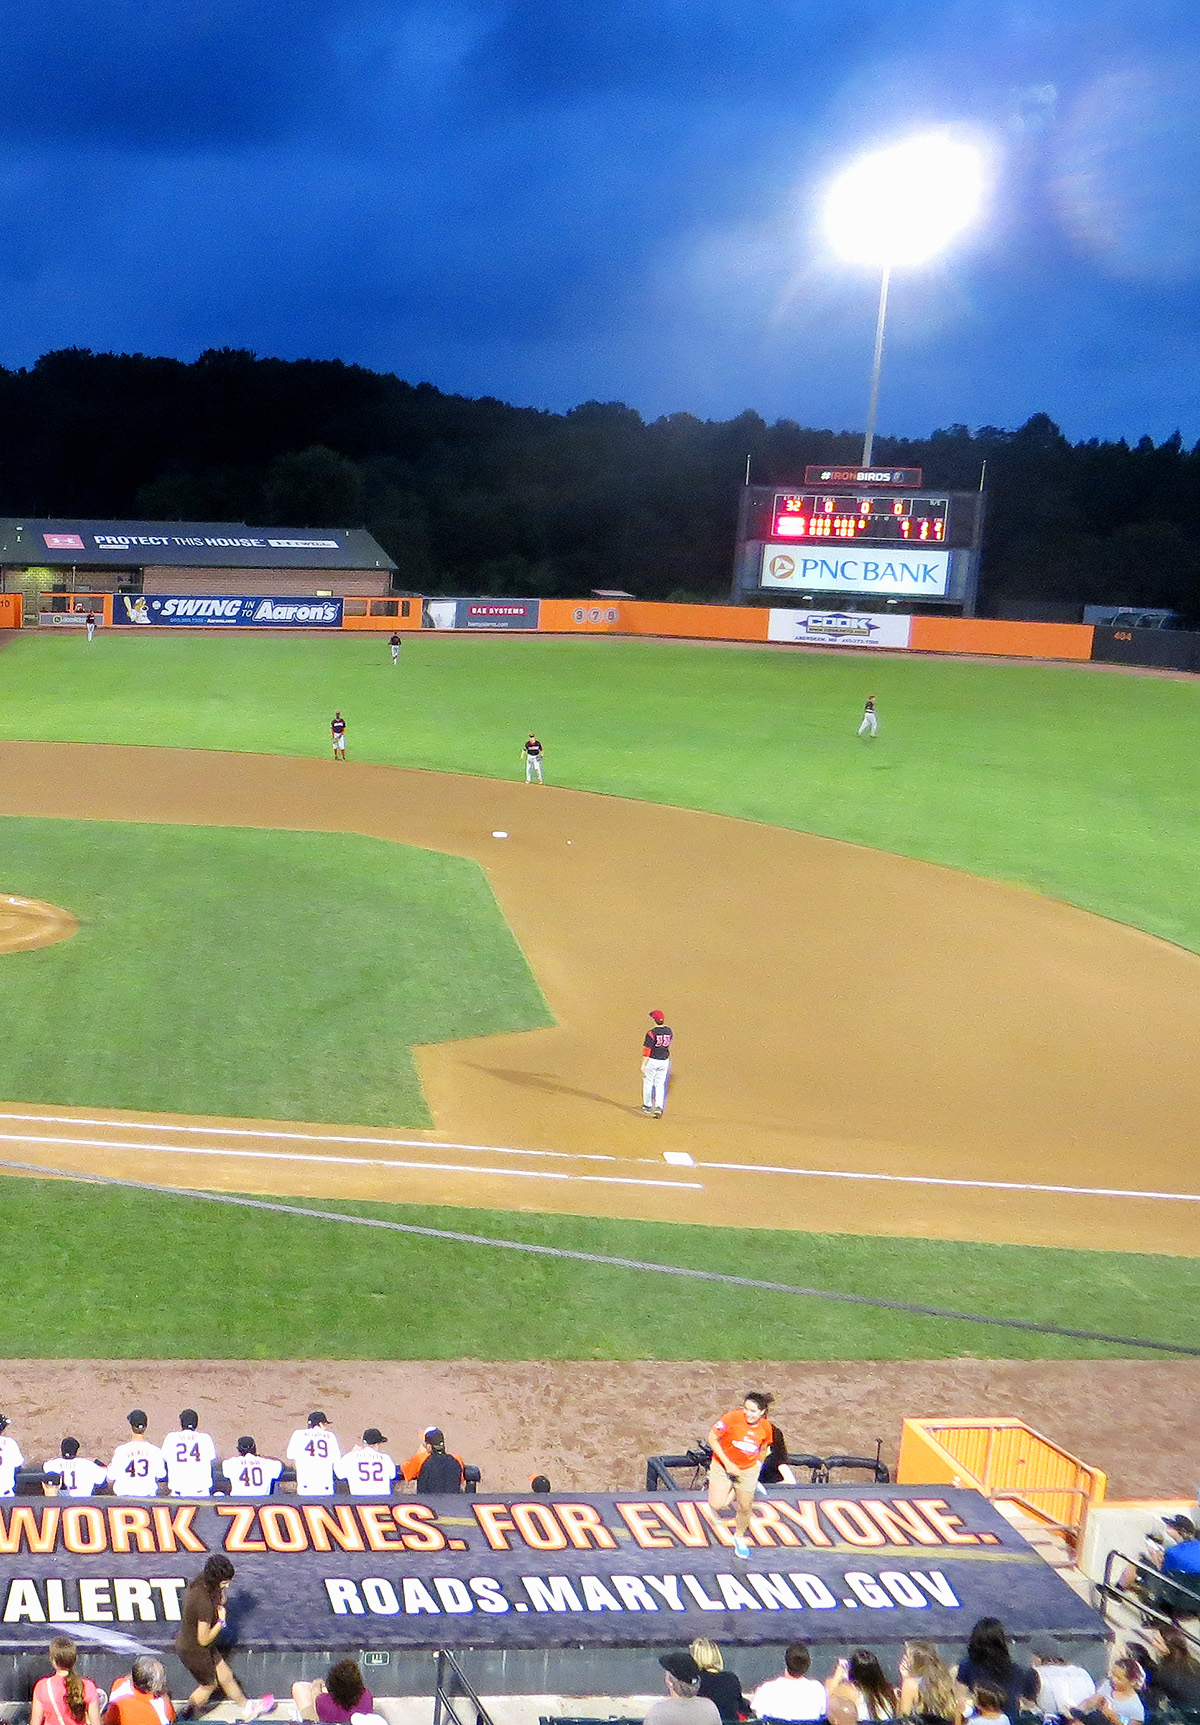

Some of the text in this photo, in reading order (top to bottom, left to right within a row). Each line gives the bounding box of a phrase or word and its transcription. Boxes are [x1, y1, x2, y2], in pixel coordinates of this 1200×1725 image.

[786, 500, 802, 511] 32
[824, 501, 834, 513] 0
[860, 502, 870, 514] 0
[894, 503, 903, 515] 0
[93, 535, 169, 546] PROTECT
[171, 536, 204, 547] THIS
[205, 537, 263, 547] HOUSE
[801, 558, 941, 584] PNC BANK
[160, 599, 337, 621] SWING IN TO Aaron's
[807, 615, 872, 629] COOK
[176, 1442, 201, 1462] 24
[304, 1439, 328, 1458] 49
[125, 1458, 149, 1478] 43
[239, 1467, 263, 1487] 40
[358, 1461, 384, 1482] 52
[216, 1502, 468, 1553] ZONES.
[476, 1501, 618, 1551] FOR
[614, 1497, 1000, 1550] EVERYONE.
[2, 1578, 187, 1623] ALERT
[324, 1570, 961, 1616] ROADS.MARYLAND.GOV
